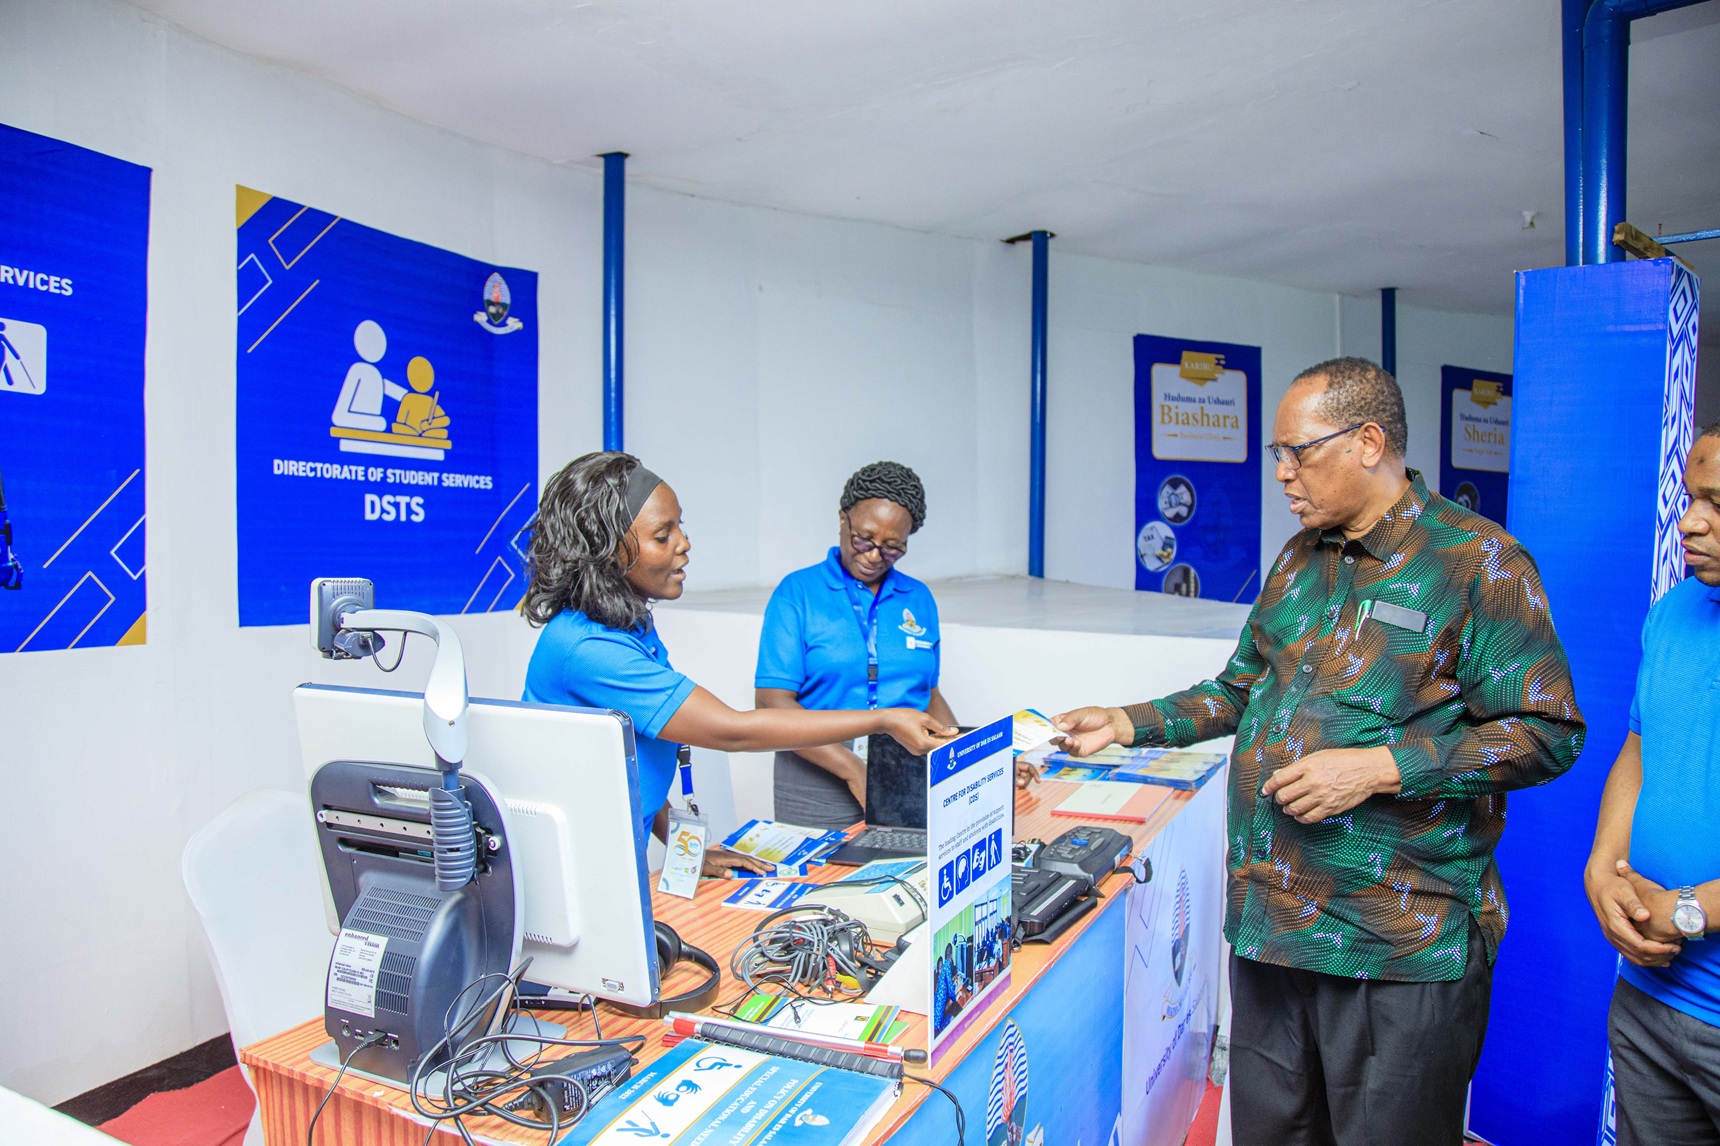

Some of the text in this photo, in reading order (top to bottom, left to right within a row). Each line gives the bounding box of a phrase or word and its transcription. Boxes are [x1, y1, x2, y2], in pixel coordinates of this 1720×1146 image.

[0, 264, 74, 296] RVICES
[1163, 392, 1236, 407] Huduma za Ushauri
[1159, 403, 1240, 430] Biashara
[1464, 422, 1505, 446] Sheria
[272, 458, 494, 490] DIRECTORATE OF STUDENT SERVICES
[363, 493, 426, 523] DSTS
[1142, 533, 1156, 543] TAX
[956, 744, 976, 759] UNIVERSITY
[975, 741, 981, 749] OF
[991, 731, 1004, 742] SALAAM
[942, 766, 1004, 809] CENTRE FOR DISABILITY SERVICES
[968, 791, 980, 806] (CDS)
[1145, 1044, 1172, 1096] University
[1177, 1018, 1186, 1041] Dar
[618, 1071, 658, 1100] MARCH 2022
[795, 1081, 823, 1109] UNIVERSITY
[687, 1065, 781, 1146] SPECIAL EDUCATIONAL NEED
[728, 1078, 799, 1146] POLICY ON DISABILITY
[740, 1099, 758, 1115] AND
[777, 1113, 793, 1126] DAR
[788, 1106, 799, 1115] OF
[771, 1123, 783, 1132] ES
